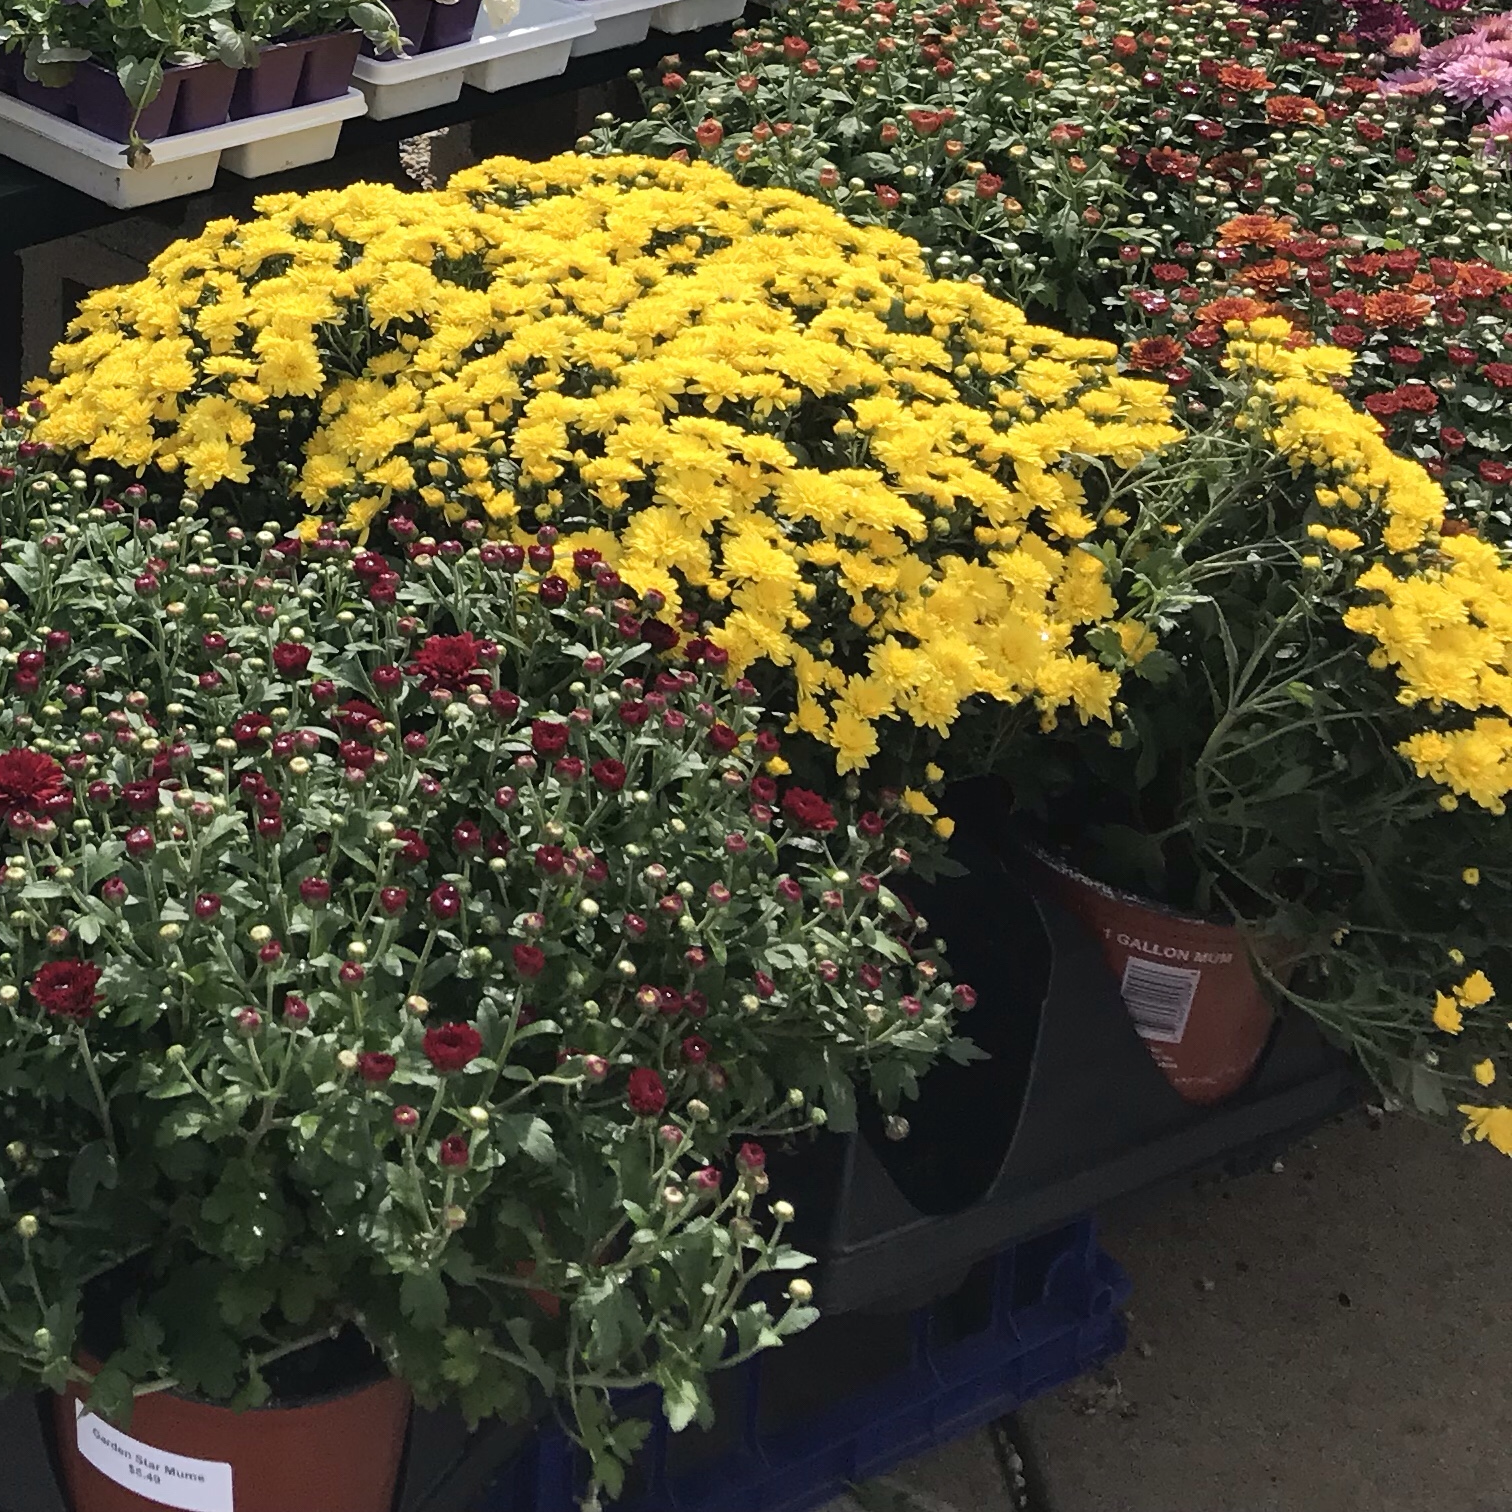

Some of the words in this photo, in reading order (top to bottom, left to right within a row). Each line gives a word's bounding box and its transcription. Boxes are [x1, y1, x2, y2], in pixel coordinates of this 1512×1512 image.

[1116, 933, 1190, 961] GALLON
[1193, 951, 1234, 964] MUM
[92, 1427, 133, 1460] Garden
[135, 1454, 161, 1472] Star
